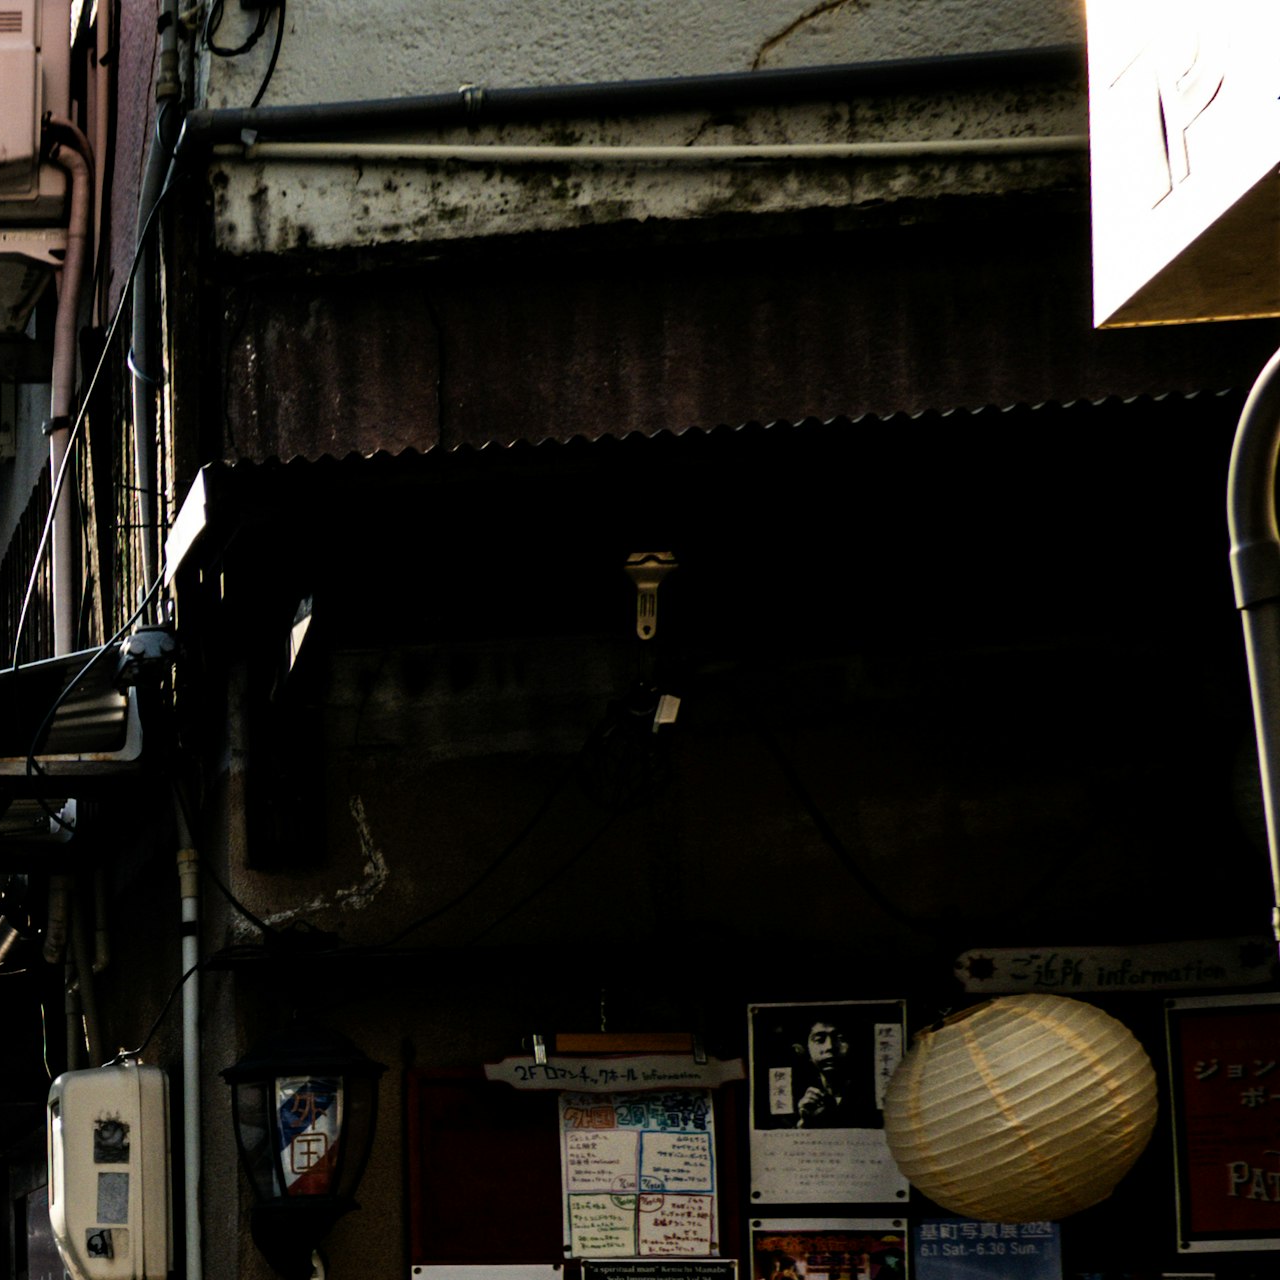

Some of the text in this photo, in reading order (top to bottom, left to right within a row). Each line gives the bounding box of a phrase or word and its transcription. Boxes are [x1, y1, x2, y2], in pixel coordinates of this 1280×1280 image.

[1096, 958, 1227, 986] information
[514, 1065, 537, 1081] 2F
[288, 1092, 330, 1176] 外国
[920, 1222, 1018, 1240] 基町写真展
